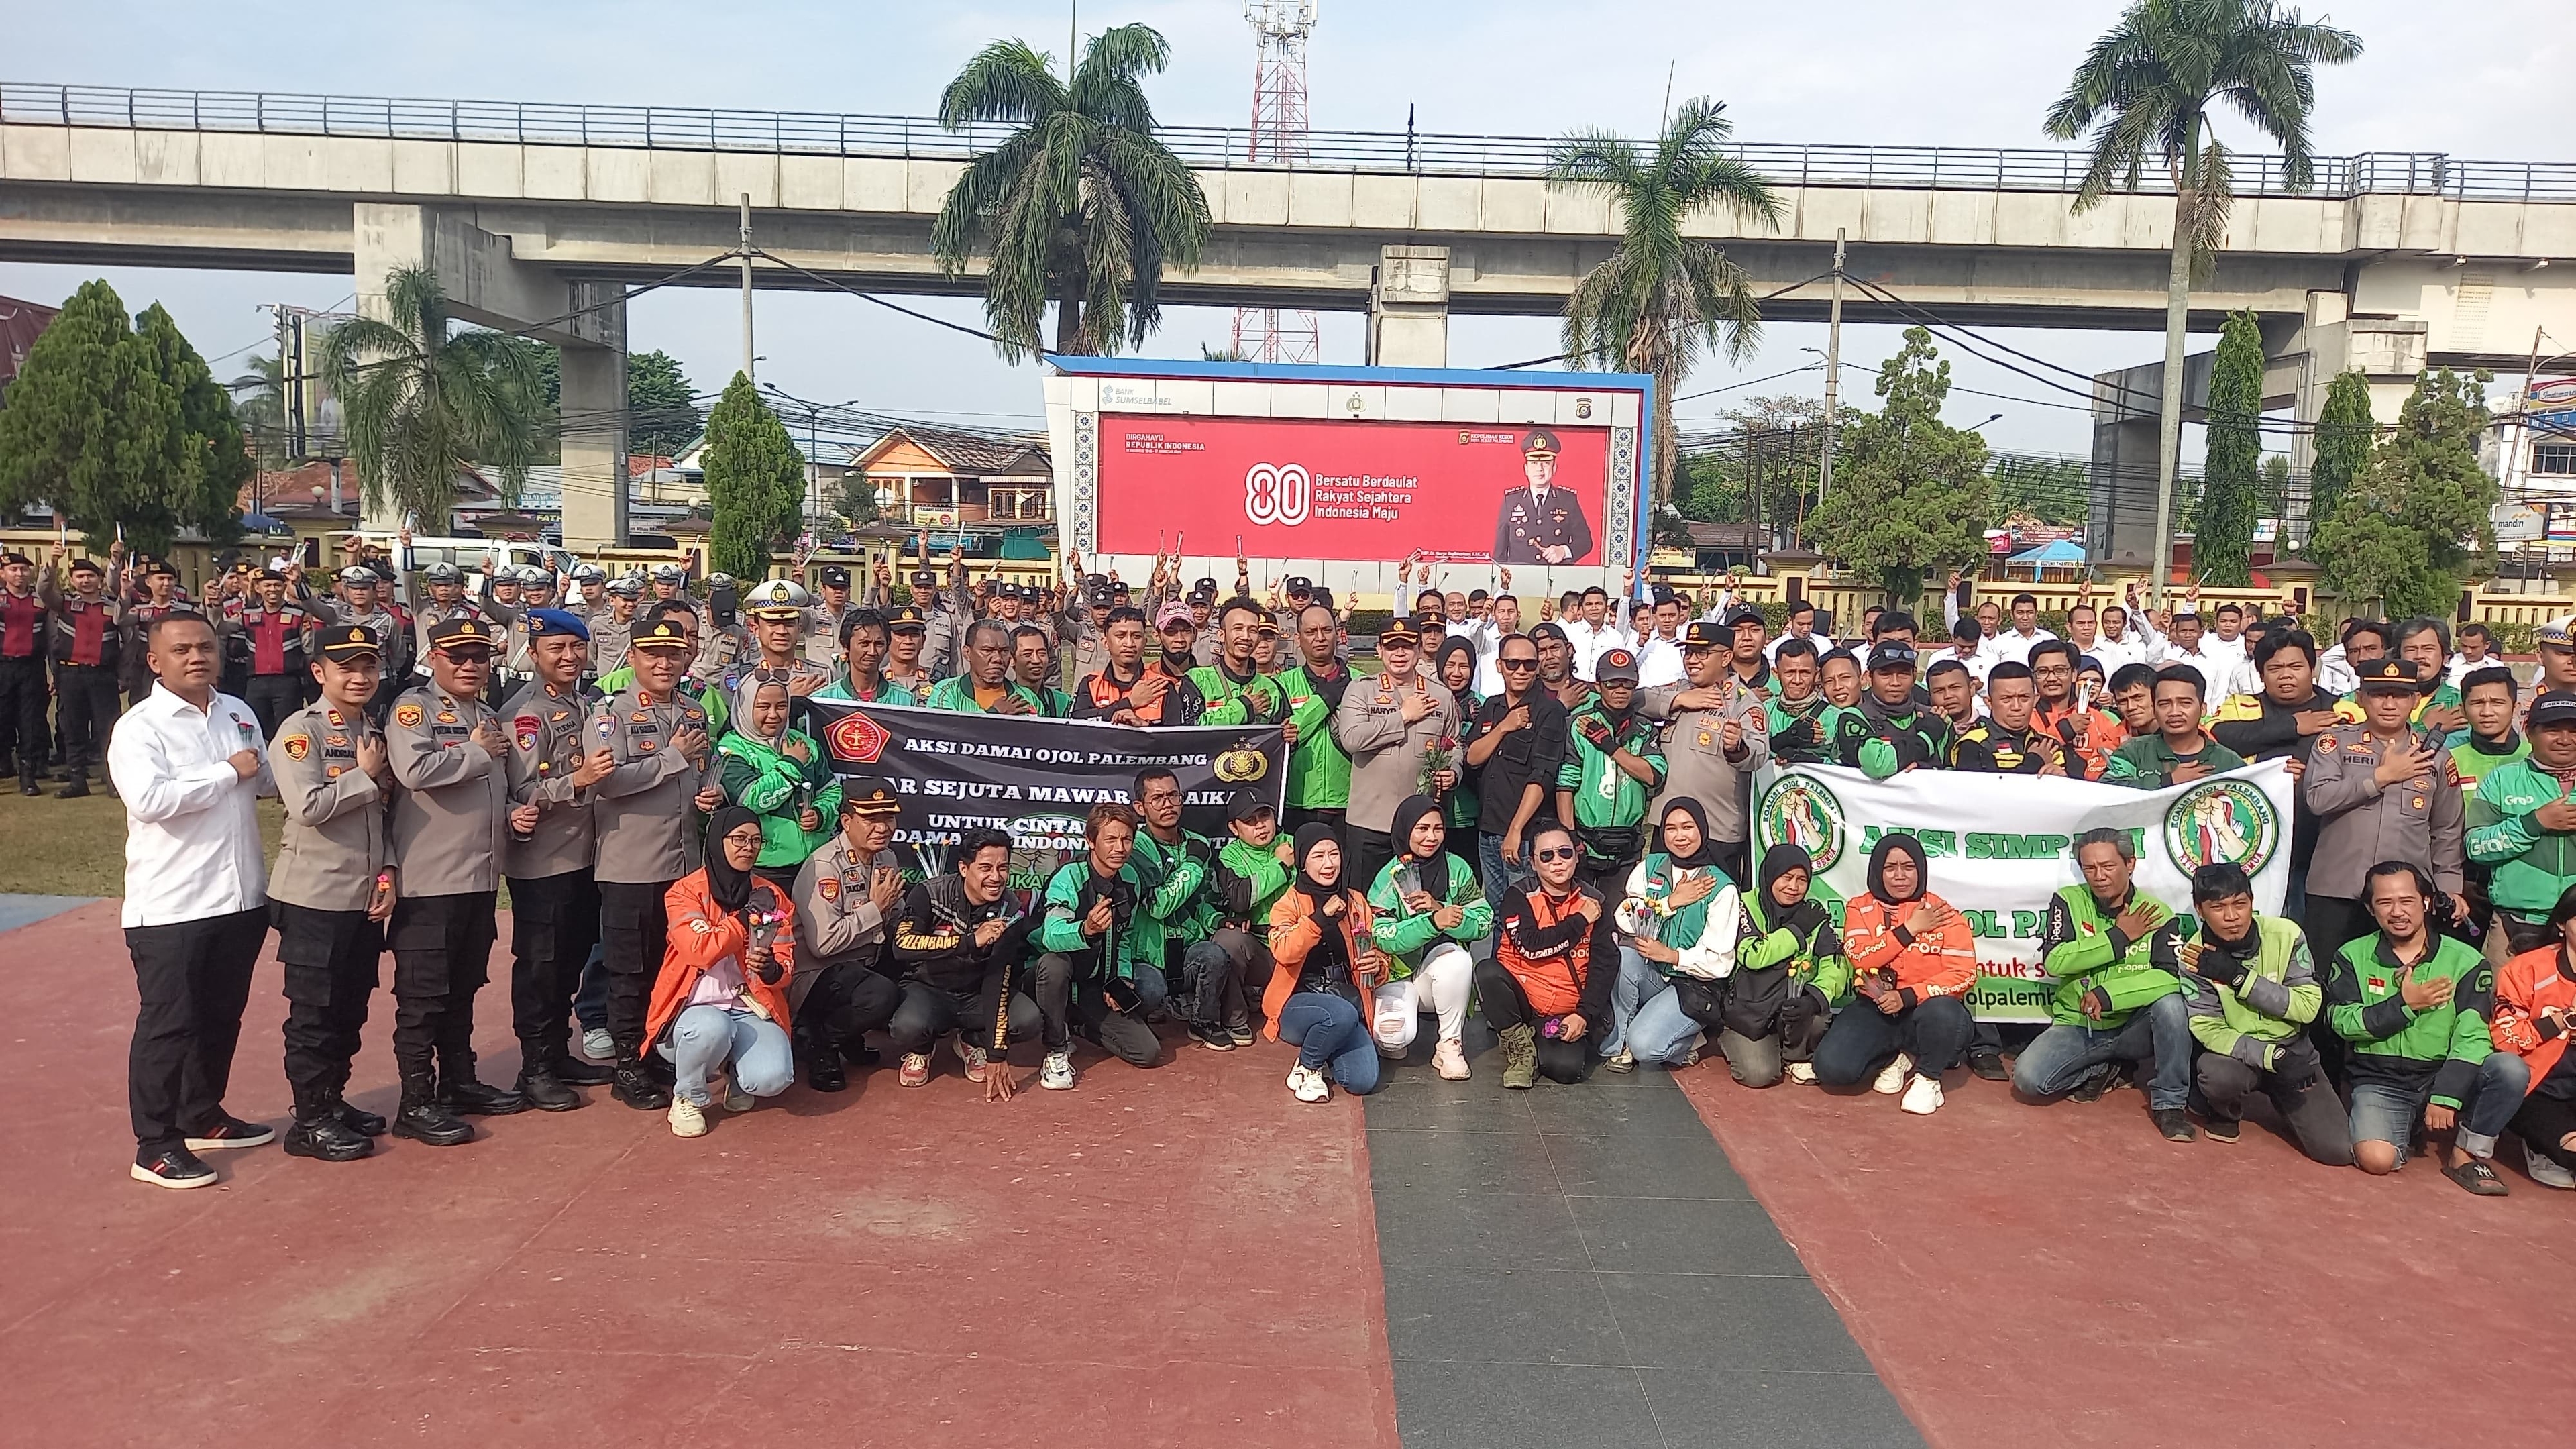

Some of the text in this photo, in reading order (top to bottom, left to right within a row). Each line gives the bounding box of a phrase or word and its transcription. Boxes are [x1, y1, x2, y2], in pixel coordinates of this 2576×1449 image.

[1115, 388, 1134, 396] BANK
[1115, 396, 1173, 405] SUMSELBABEL
[1126, 433, 1164, 441] DIRGAHAYU
[1126, 441, 1205, 451] REPUBLIK INDONESIA
[1315, 474, 1418, 488] Bersatu Berdaulat
[1245, 462, 1310, 526] 80
[1315, 489, 1412, 506] Rakyat Sejahtera
[1314, 504, 1399, 522] Indonesia Maju
[904, 738, 1208, 767] AKSI DAMAI OJOL PALEMBANG
[2343, 755, 2375, 765] HERI
[924, 778, 1022, 800] SEJUTA
[1028, 786, 1132, 805] MAWAR
[2504, 794, 2534, 806] Grab
[1763, 788, 1781, 822] KOALISI
[1782, 780, 1800, 790] OJOL
[2171, 784, 2270, 829] KOALISI OJOL PALEMBANG
[1013, 817, 1086, 835] CINTA
[891, 829, 966, 846] DAMA
[1964, 828, 2146, 860] SIMPI
[2470, 833, 2514, 856] Grab
[1816, 848, 1837, 868] SEMUA
[2241, 853, 2265, 873] EMUA
[1976, 957, 2027, 978] ntuk
